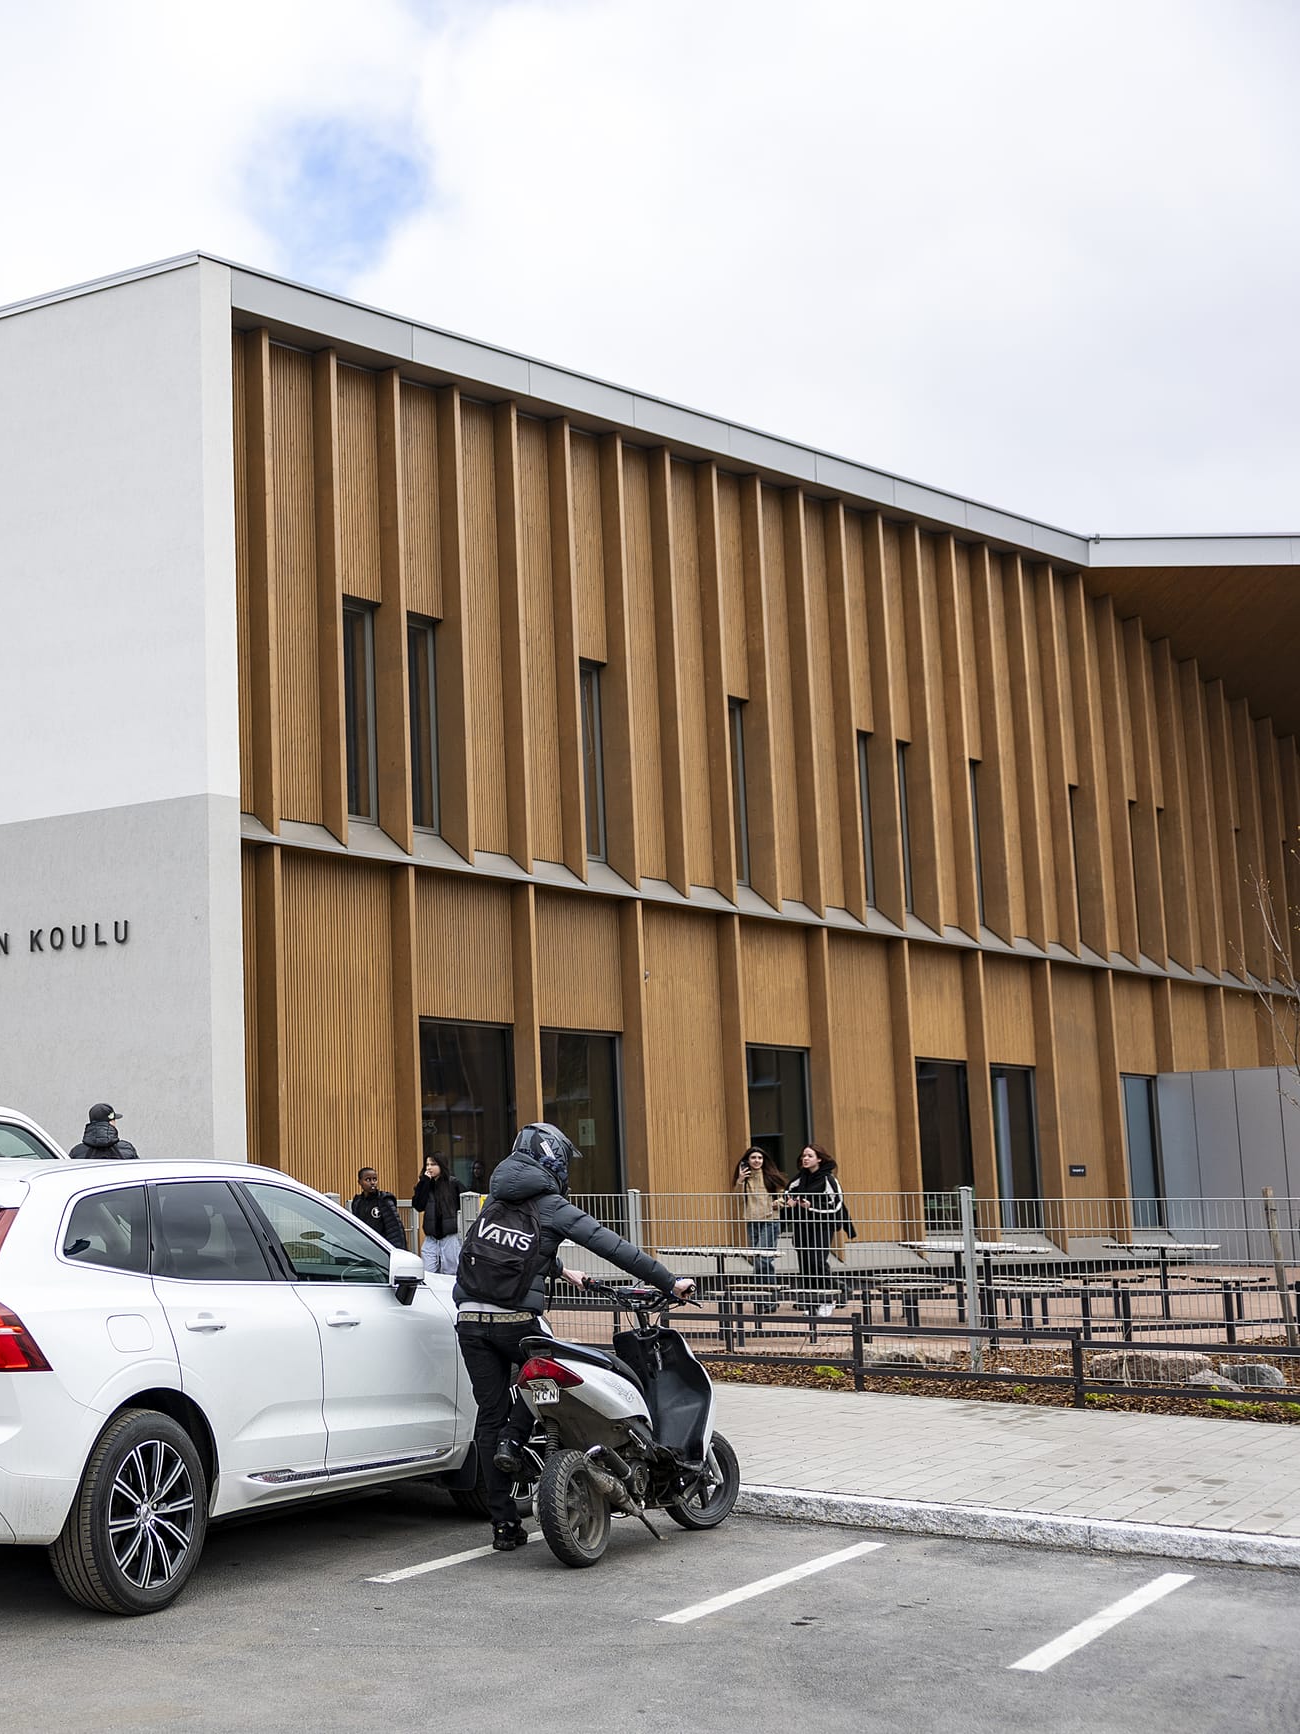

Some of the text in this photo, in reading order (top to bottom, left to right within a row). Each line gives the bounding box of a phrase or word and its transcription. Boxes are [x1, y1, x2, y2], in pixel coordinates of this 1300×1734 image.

[29, 920, 129, 952] KOULU
[478, 1218, 535, 1251] VANS
[534, 1390, 556, 1401] NCN
